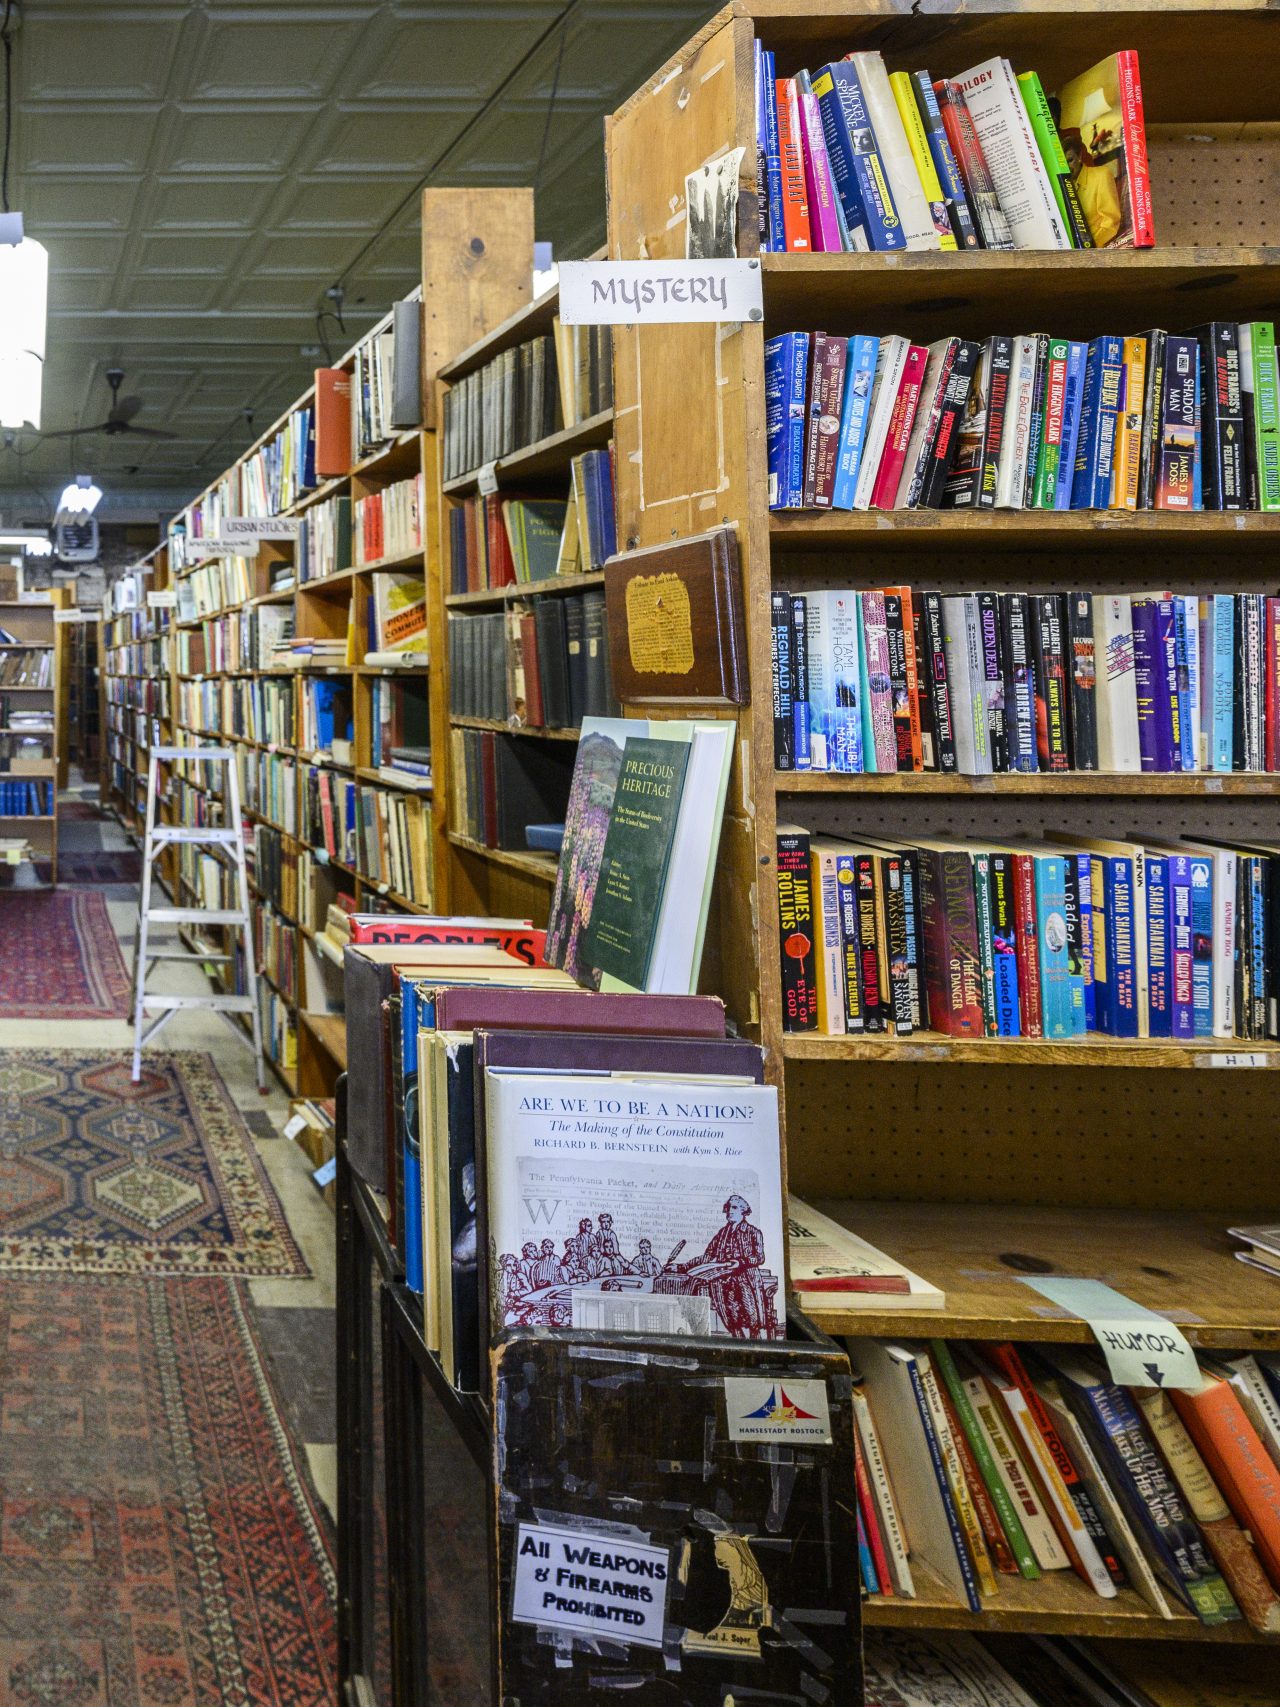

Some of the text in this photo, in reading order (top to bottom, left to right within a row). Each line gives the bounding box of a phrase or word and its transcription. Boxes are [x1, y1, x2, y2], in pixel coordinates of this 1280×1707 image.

[835, 79, 859, 129] SPILLANE
[846, 83, 867, 123] MICKEY
[1035, 88, 1058, 136] BANGKOK
[591, 275, 728, 314] MYSTERY
[1047, 360, 1065, 444] MARY HIGGINS CLARK
[1169, 388, 1181, 412] MAN
[1182, 377, 1195, 425] SHADOW
[832, 636, 844, 673] HOAG
[843, 641, 855, 668] TAMI
[1040, 622, 1051, 650] LOWELL
[1049, 617, 1061, 655] ELIZABETH
[770, 626, 781, 719] PICTURES OF PERFECTION
[777, 625, 790, 720] REGINALD HILL
[1048, 679, 1063, 752] ALWAYS TIME TO DIE
[621, 777, 672, 799] HERITAGE
[625, 760, 676, 780] PRECIOUS
[777, 871, 797, 931] ROLLINS
[793, 878, 811, 923] JAMES
[995, 871, 1008, 928] James Swain
[1113, 883, 1132, 966] SARAH SHANKMAN
[787, 989, 798, 1018] GOD
[797, 978, 809, 1024] EYE OF
[807, 985, 817, 1015] THE
[999, 956, 1013, 1037] Loaded Dice
[519, 1097, 755, 1120] ARE WE TO BE A NATION?
[534, 1138, 743, 1157] RICHARD B. BERNSTEIN with Kym S. Rice
[549, 1120, 725, 1139] The Making of the Constitution
[1101, 1330, 1185, 1355] HUMOR
[739, 1426, 826, 1436] HANSESTADT ROSTOCK
[923, 1370, 959, 1476] Belshaw Trickster
[868, 1431, 905, 1561] SLIGHTLY OVERDRAWN
[519, 1535, 668, 1582] All WEAPONS
[534, 1566, 655, 1603] & FIREARMS
[542, 1591, 646, 1627] PROHIBITED
[721, 1632, 730, 1643] J.
[731, 1633, 752, 1645] Soper
